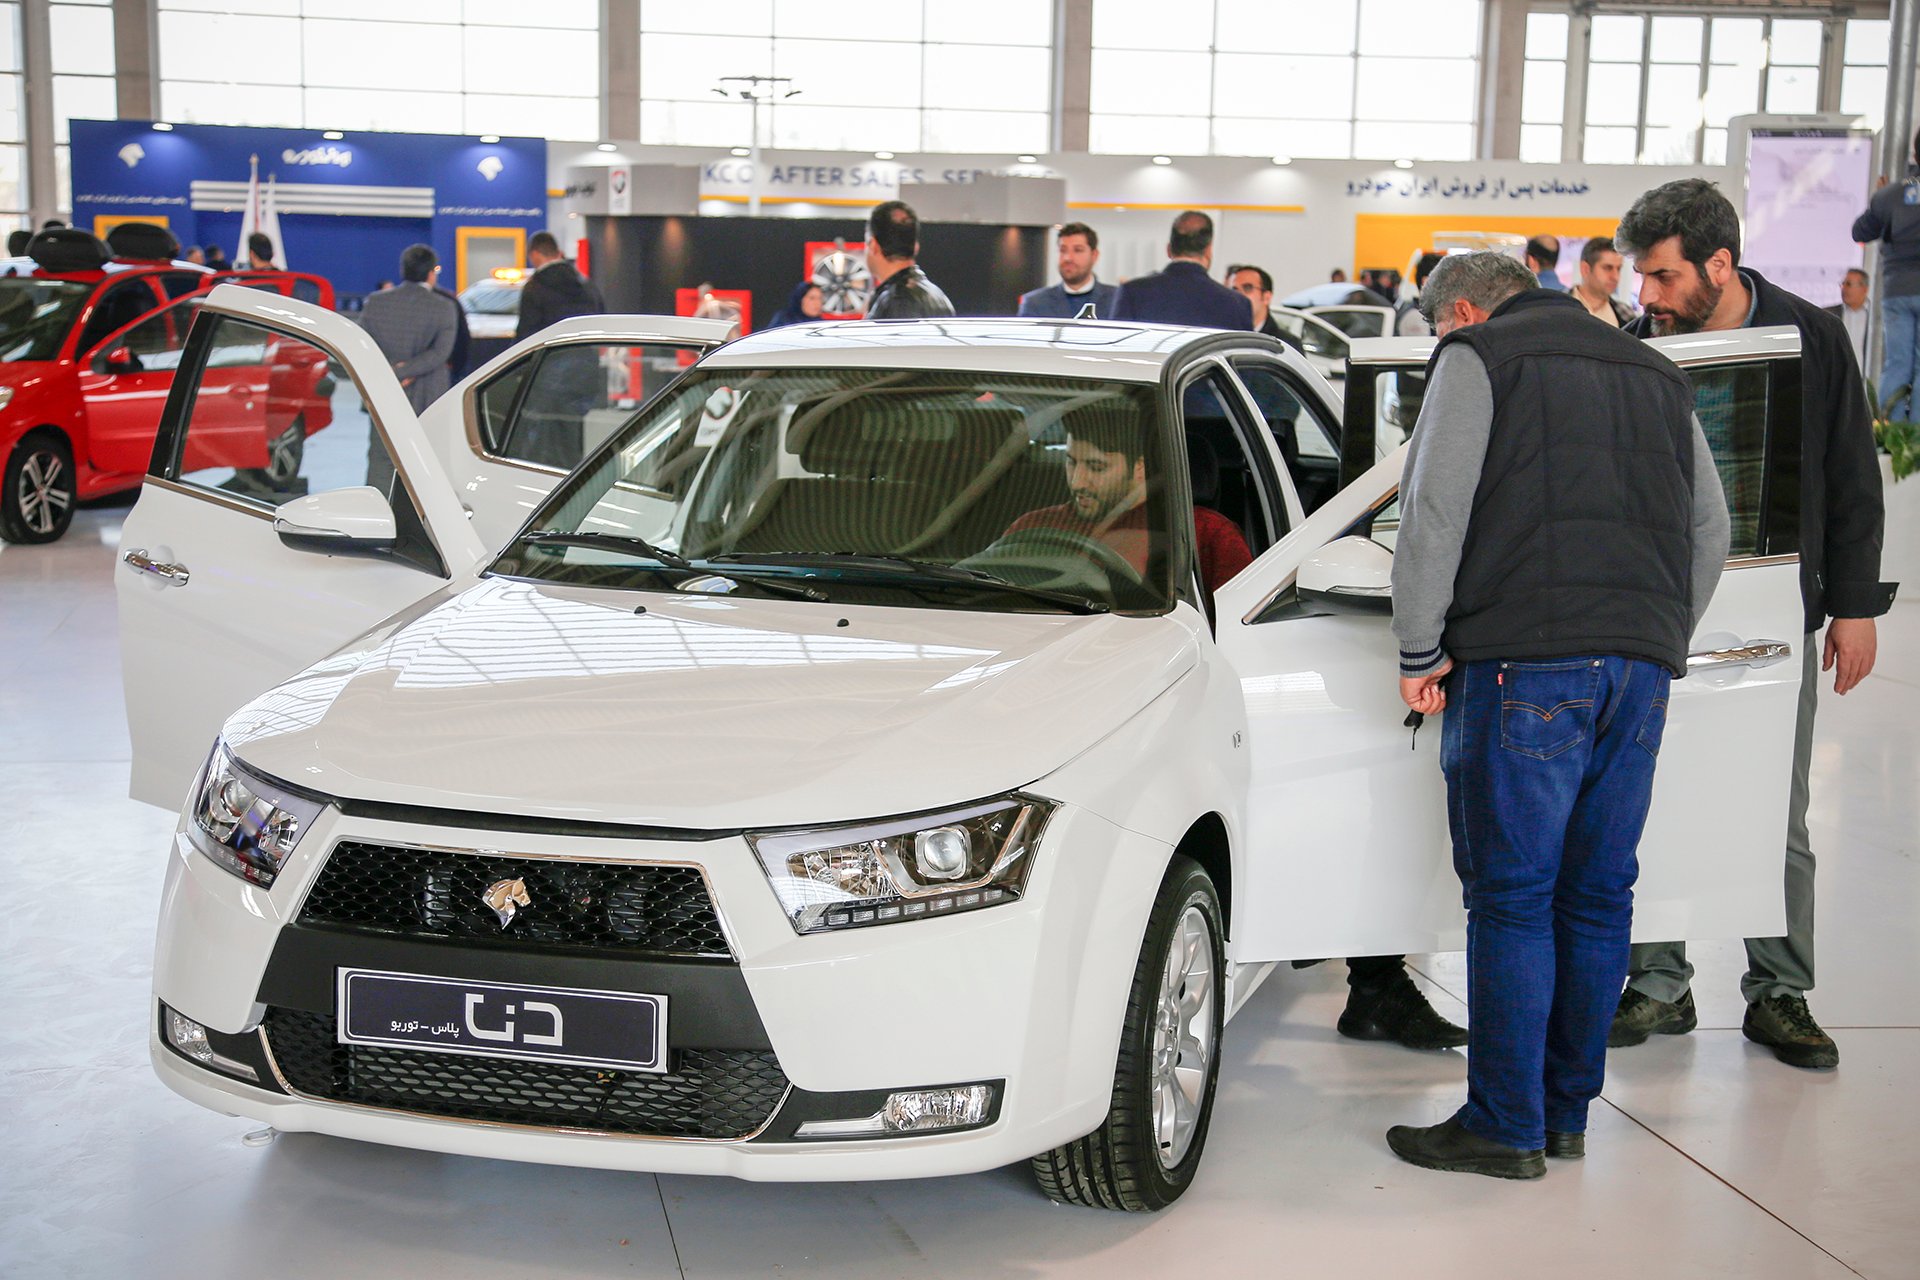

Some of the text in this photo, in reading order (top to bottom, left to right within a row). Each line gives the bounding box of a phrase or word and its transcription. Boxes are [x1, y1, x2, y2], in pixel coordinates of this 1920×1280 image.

[703, 163, 753, 184] KCO
[769, 164, 845, 187] AFTER
[850, 166, 926, 188] SALES
[1345, 175, 1590, 199] خدمات پس از فروش ایران خودرو
[465, 993, 563, 1047] دنا
